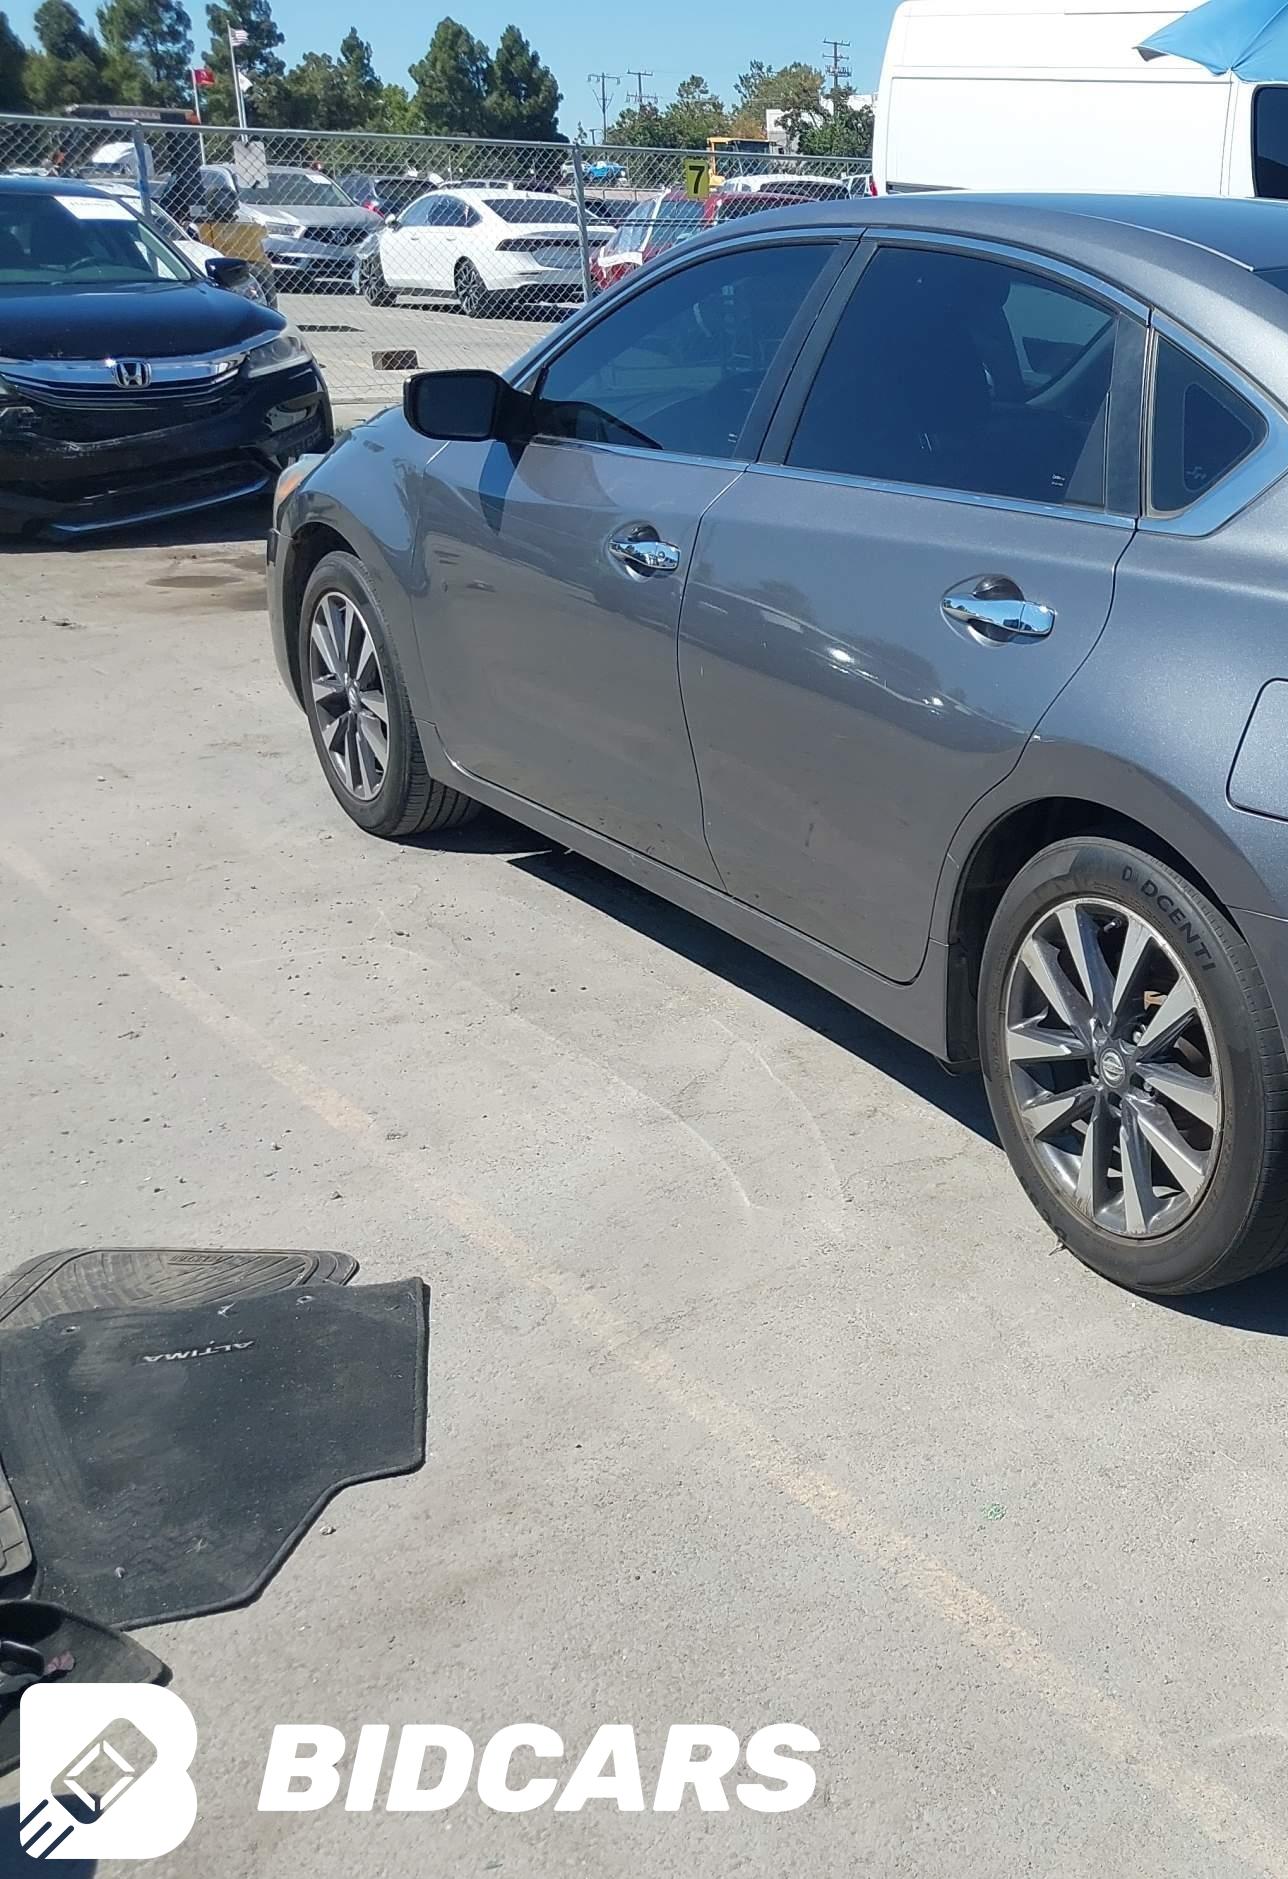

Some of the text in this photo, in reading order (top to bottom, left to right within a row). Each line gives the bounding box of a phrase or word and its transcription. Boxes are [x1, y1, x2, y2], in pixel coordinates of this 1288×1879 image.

[689, 165, 705, 194] 7
[1141, 879, 1217, 971] DCENTI
[143, 1340, 255, 1362] ALTIMA
